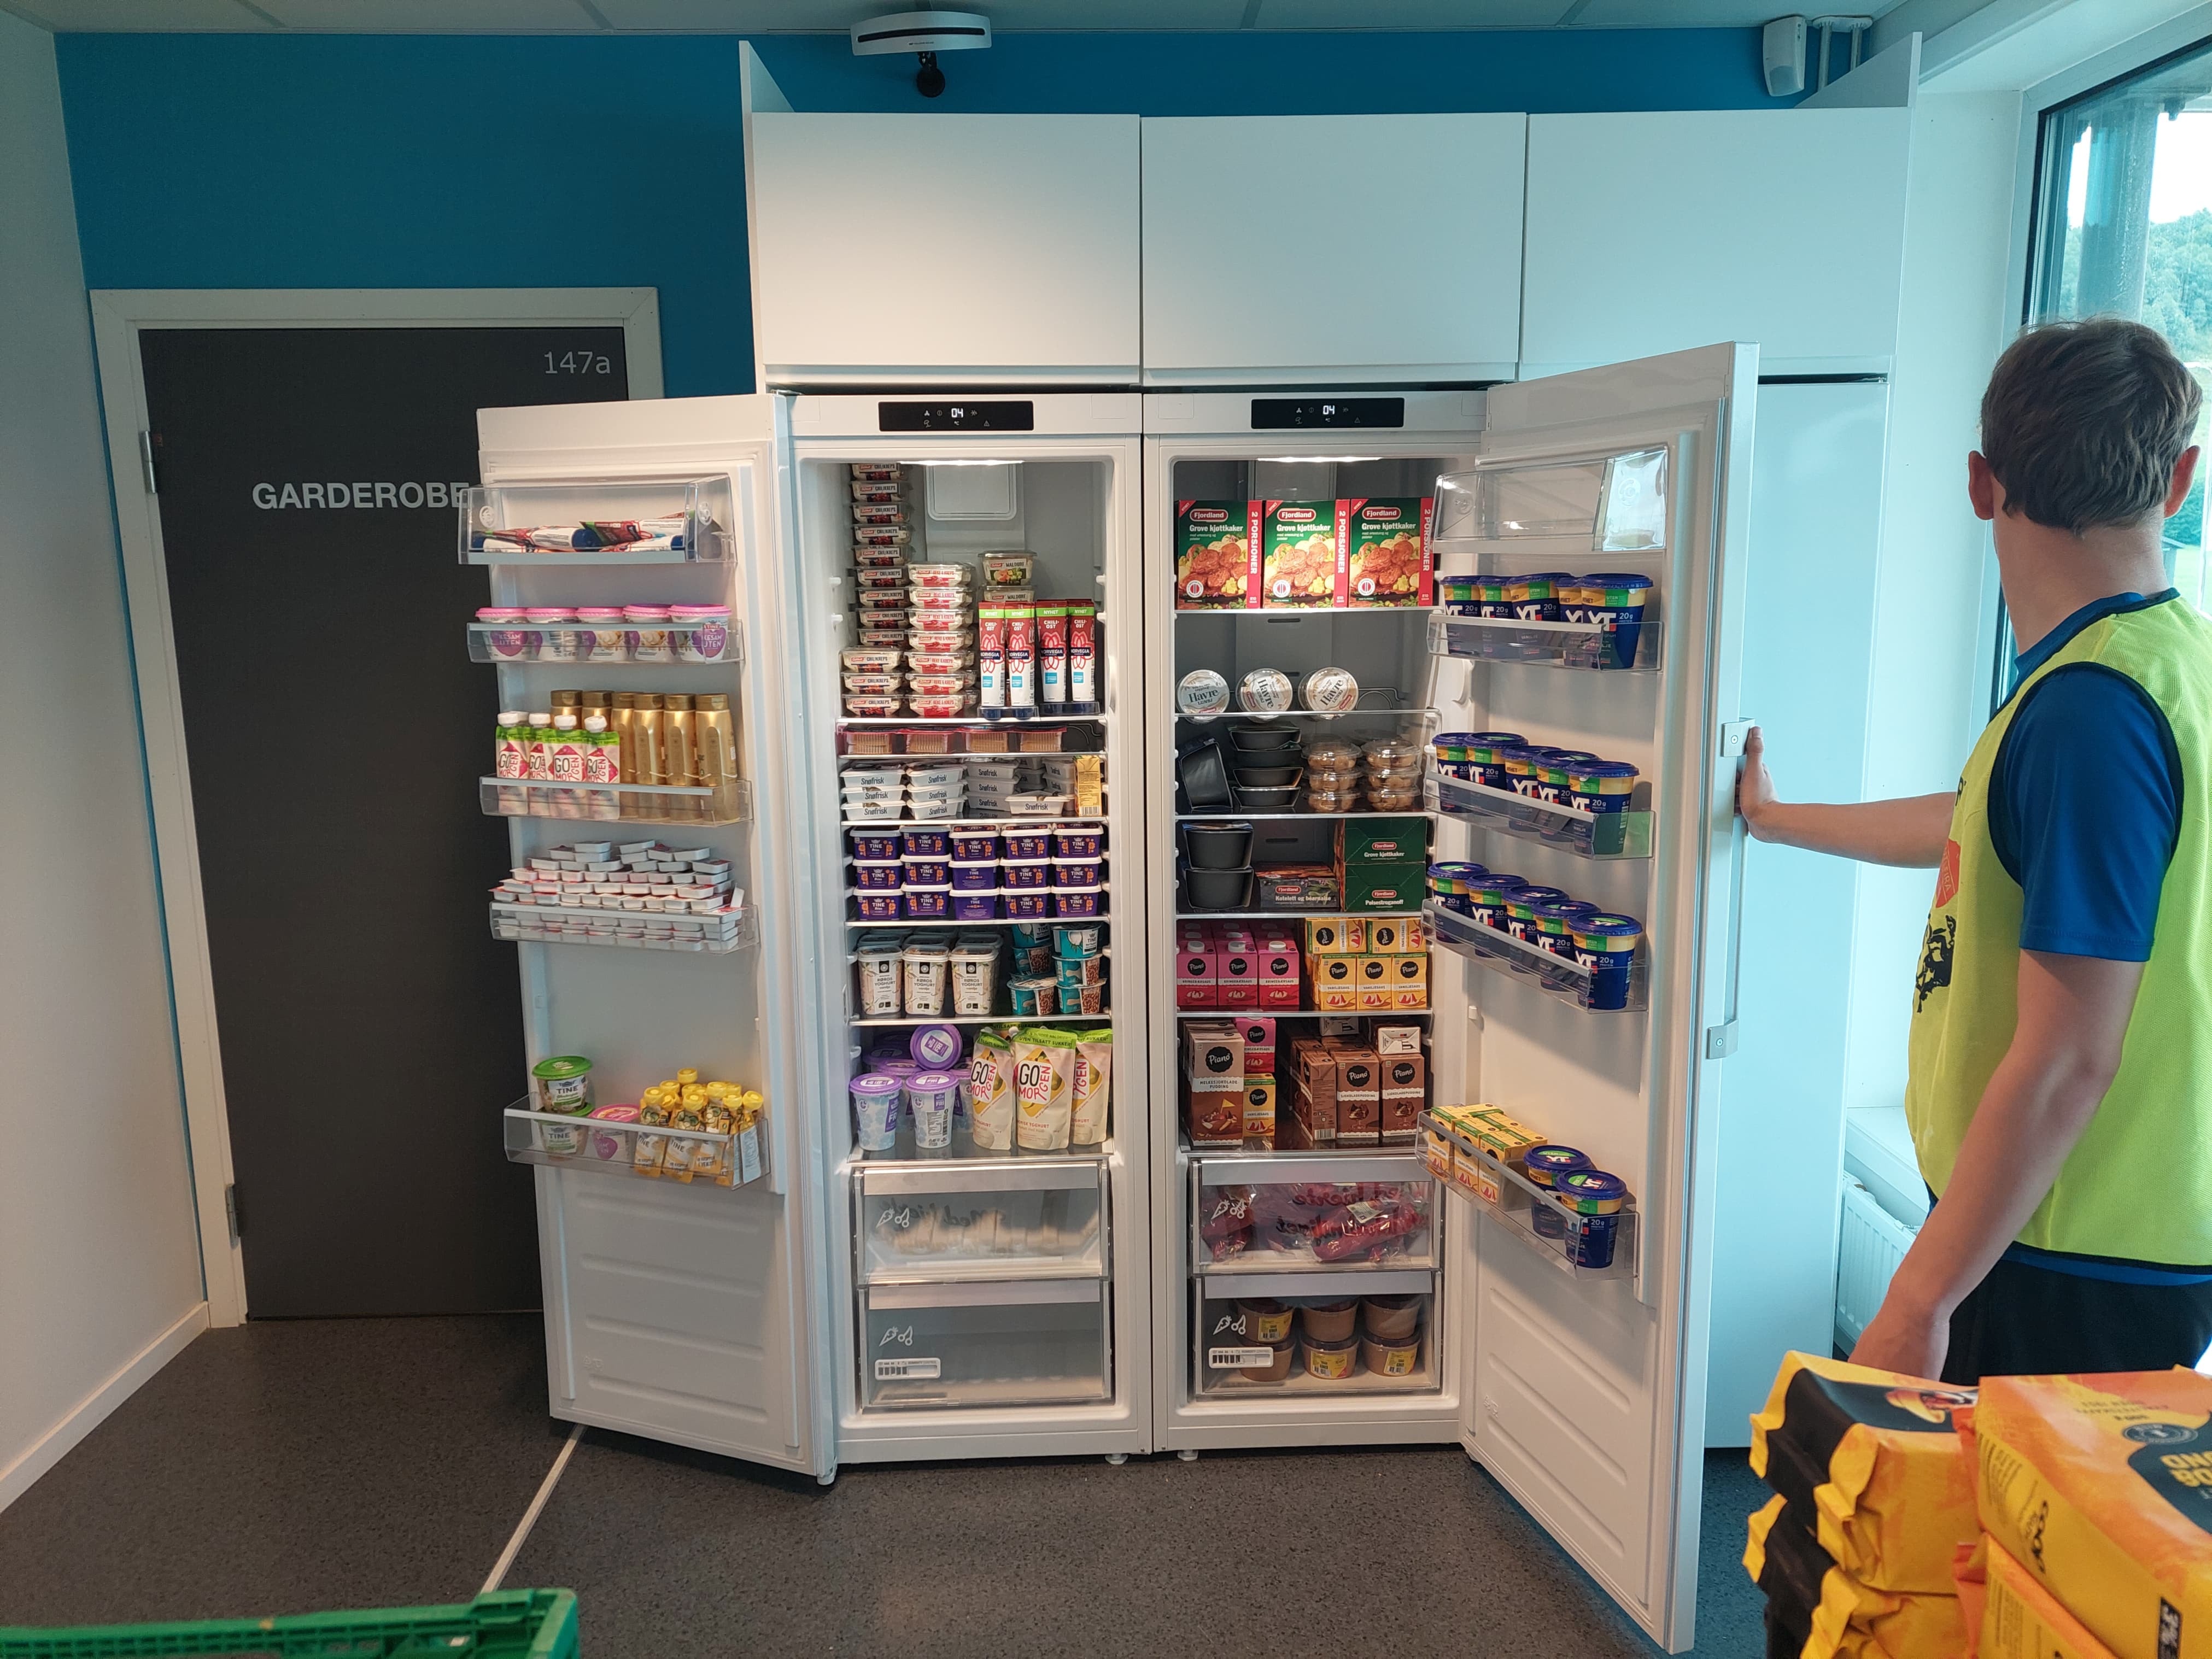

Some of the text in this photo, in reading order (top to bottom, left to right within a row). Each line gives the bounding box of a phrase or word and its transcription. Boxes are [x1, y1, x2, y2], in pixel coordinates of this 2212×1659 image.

[544, 351, 611, 374] 147a
[951, 408, 963, 418] 04
[1323, 405, 1335, 415] 04
[252, 482, 469, 509] GARDEROBE
[1297, 524, 1331, 532] kjøttkaker
[1250, 520, 1259, 574] PORSJONER
[1188, 689, 1219, 703] Havre
[1258, 679, 1274, 709] Havre
[1320, 679, 1344, 706] Havre
[500, 754, 510, 769] GO
[555, 758, 570, 772] GO
[928, 775, 946, 783] Snøfrisk
[929, 790, 947, 799] Snøfrisk
[929, 807, 947, 815] Snøfrisk
[1208, 1054, 1230, 1065] Piano
[971, 1061, 989, 1084] GO
[1020, 1063, 1040, 1086] GO
[1349, 1071, 1367, 1081] Piano
[1395, 1068, 1413, 1078] Piano
[556, 1086, 578, 1094] TINE
[888, 1113, 897, 1122] FR
